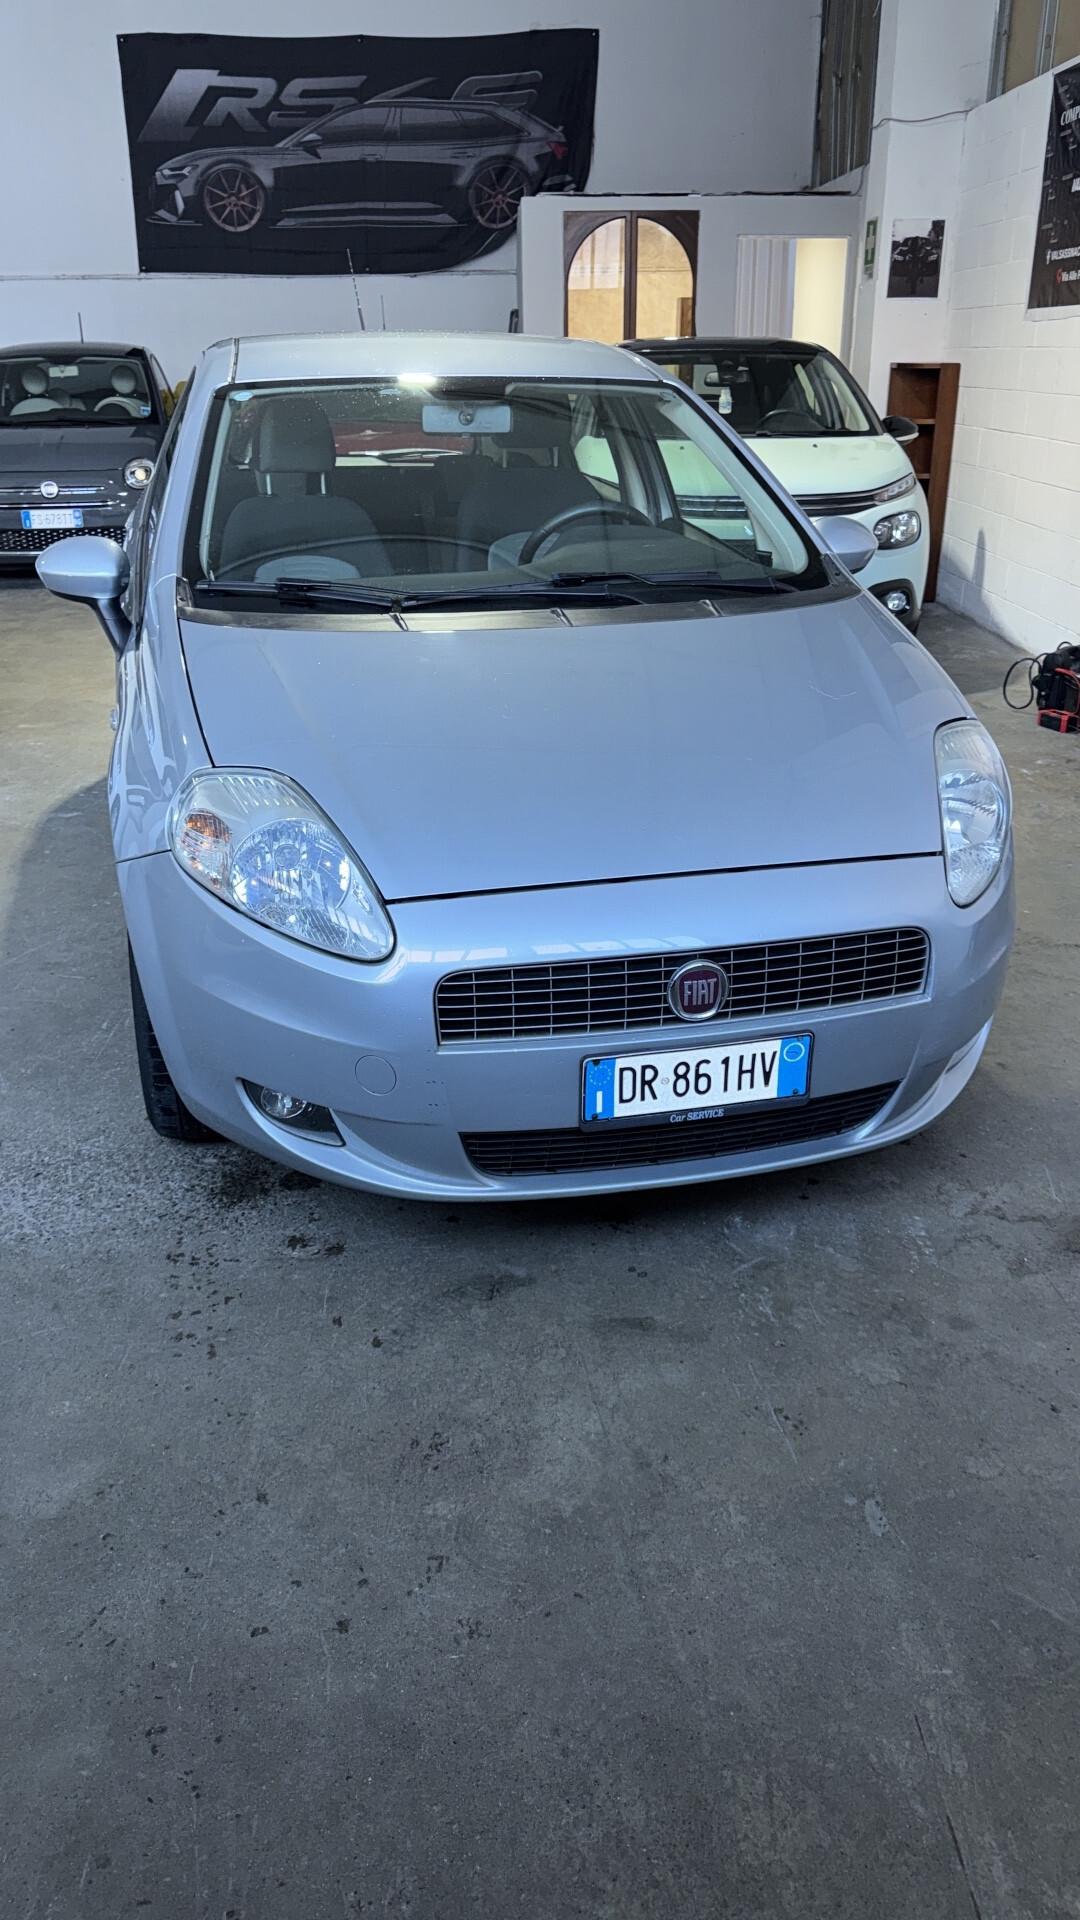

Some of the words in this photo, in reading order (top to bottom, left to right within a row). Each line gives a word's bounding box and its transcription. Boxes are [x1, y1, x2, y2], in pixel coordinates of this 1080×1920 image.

[1061, 104, 1080, 126] COMP
[683, 977, 718, 1007] FIAT
[618, 1063, 659, 1105] DR
[672, 1050, 778, 1098] 861HV
[669, 1113, 686, 1123] Car
[687, 1108, 725, 1121] SERVICE
